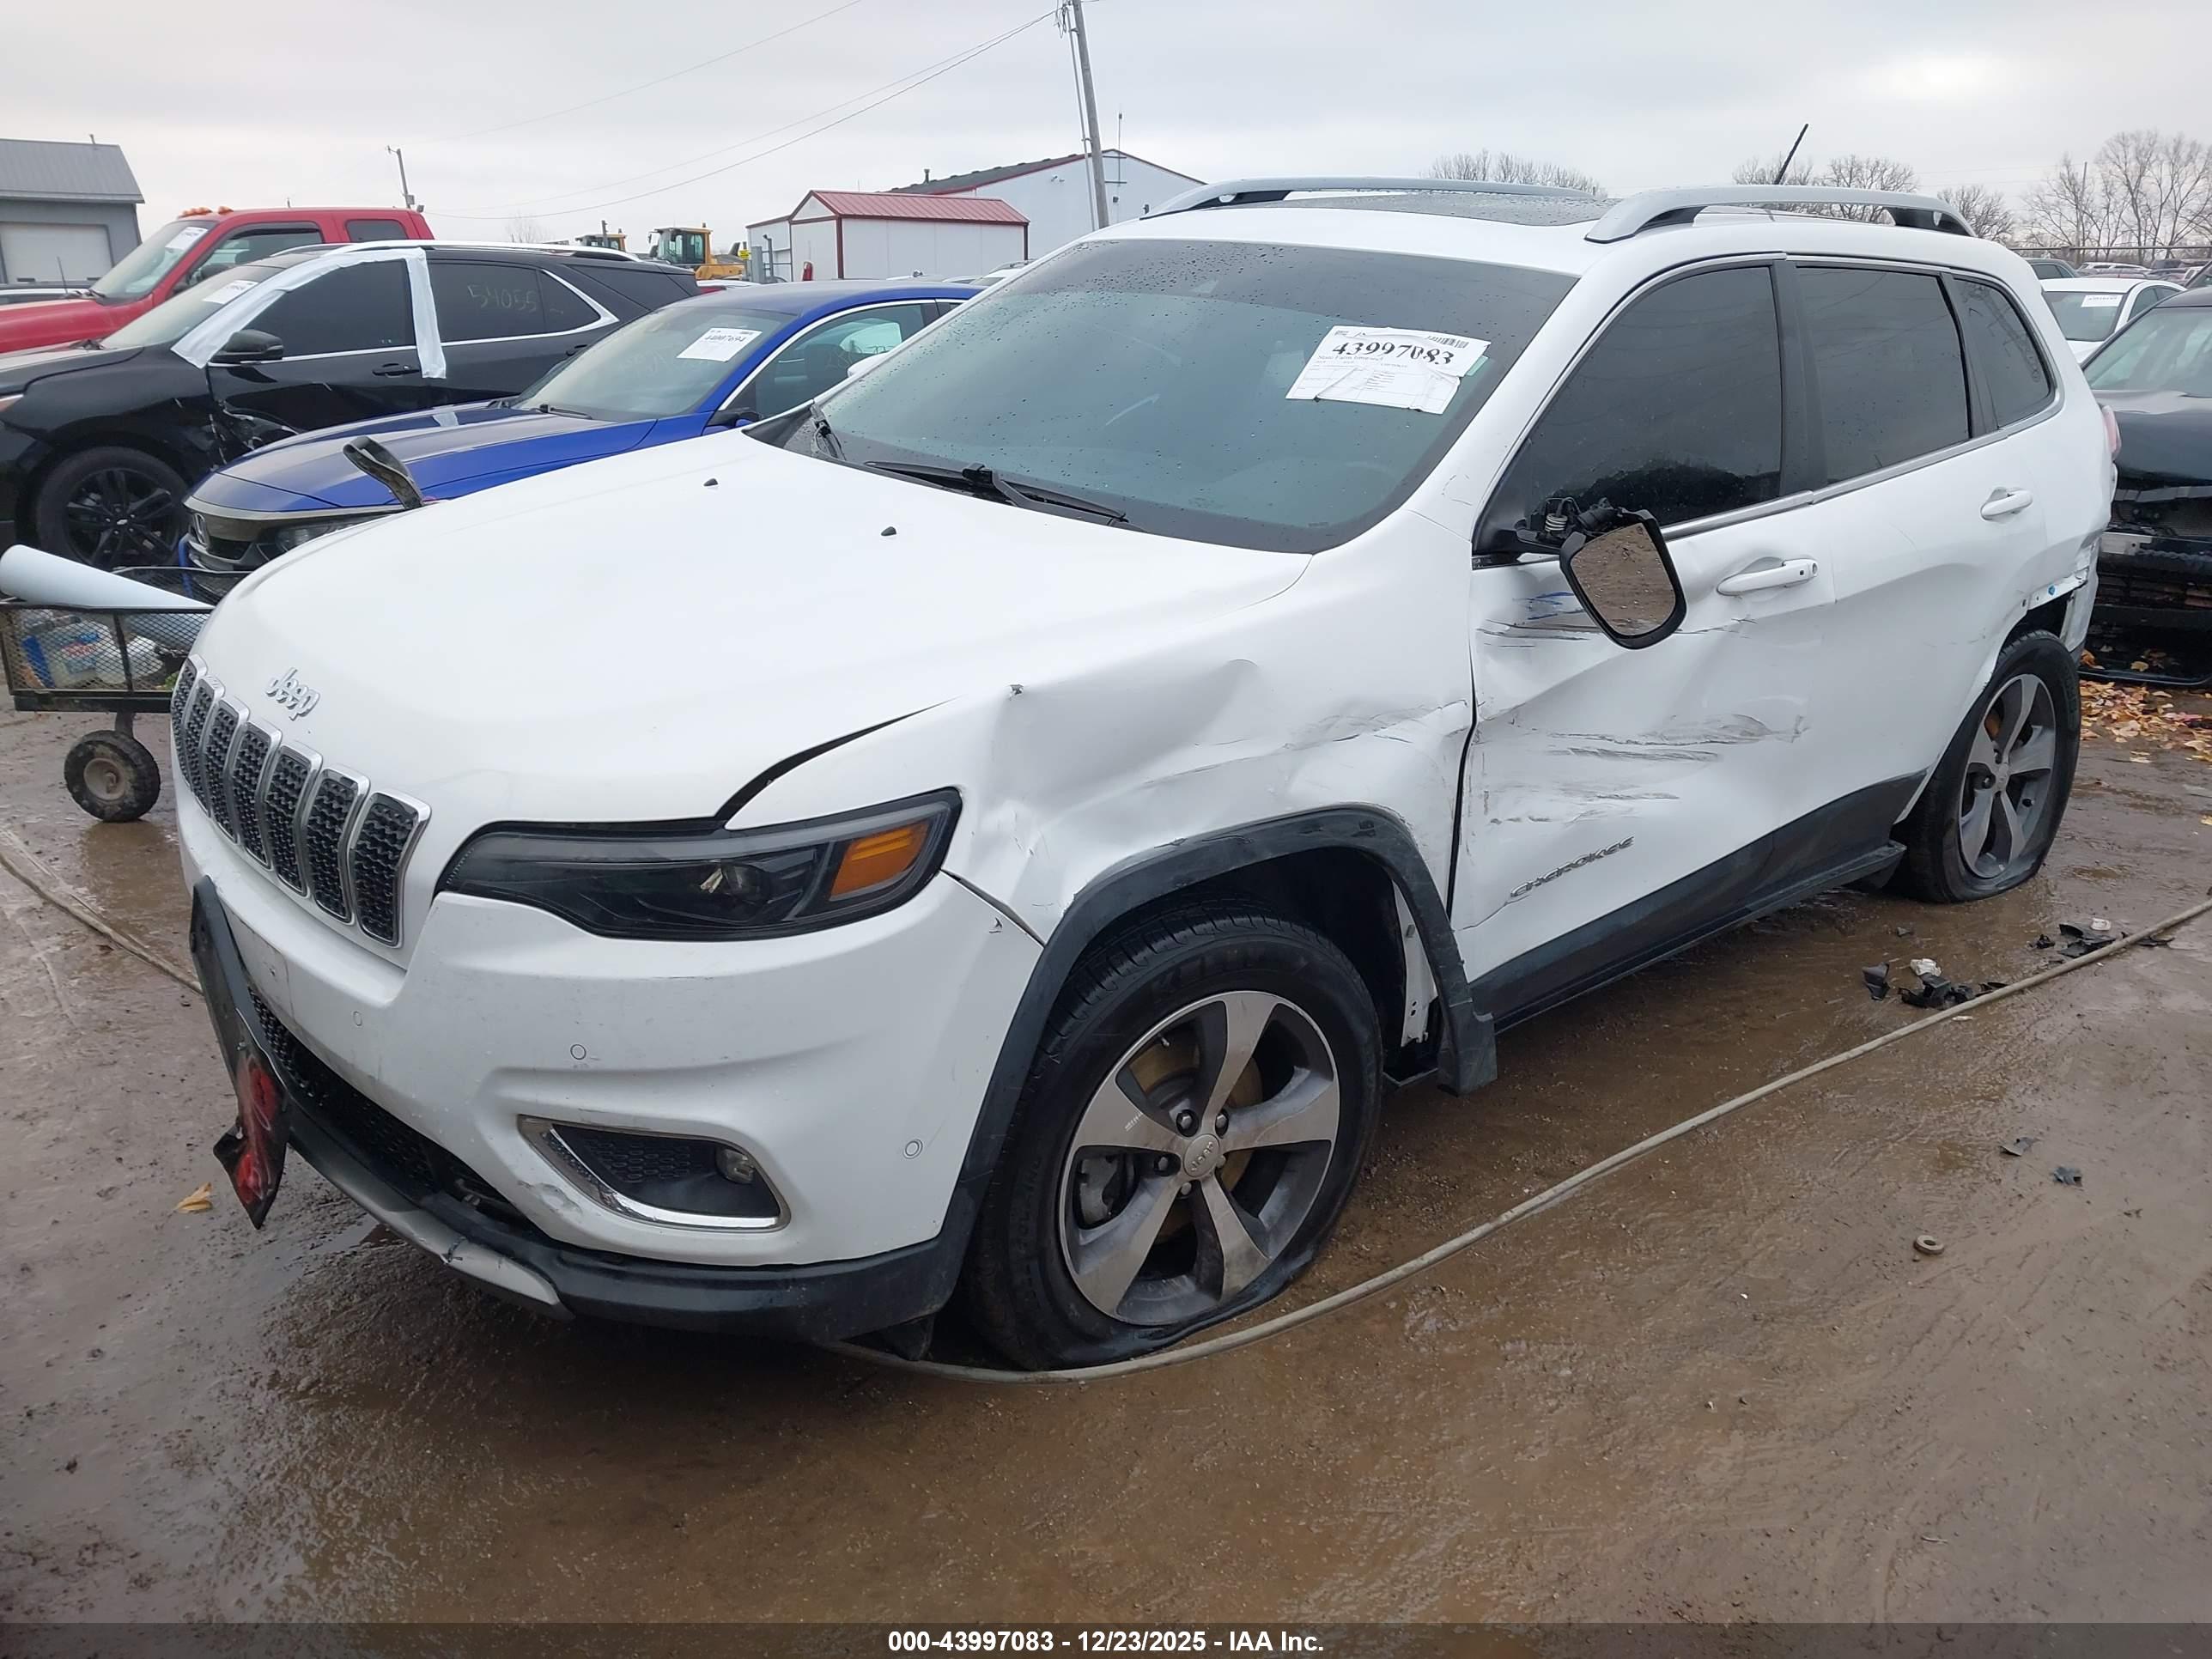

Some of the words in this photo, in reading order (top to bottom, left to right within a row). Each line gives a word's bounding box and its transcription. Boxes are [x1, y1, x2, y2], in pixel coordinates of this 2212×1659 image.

[1332, 341, 1455, 365] 43997083
[264, 666, 321, 722] Jeep
[1190, 1141, 1214, 1172] Jeep
